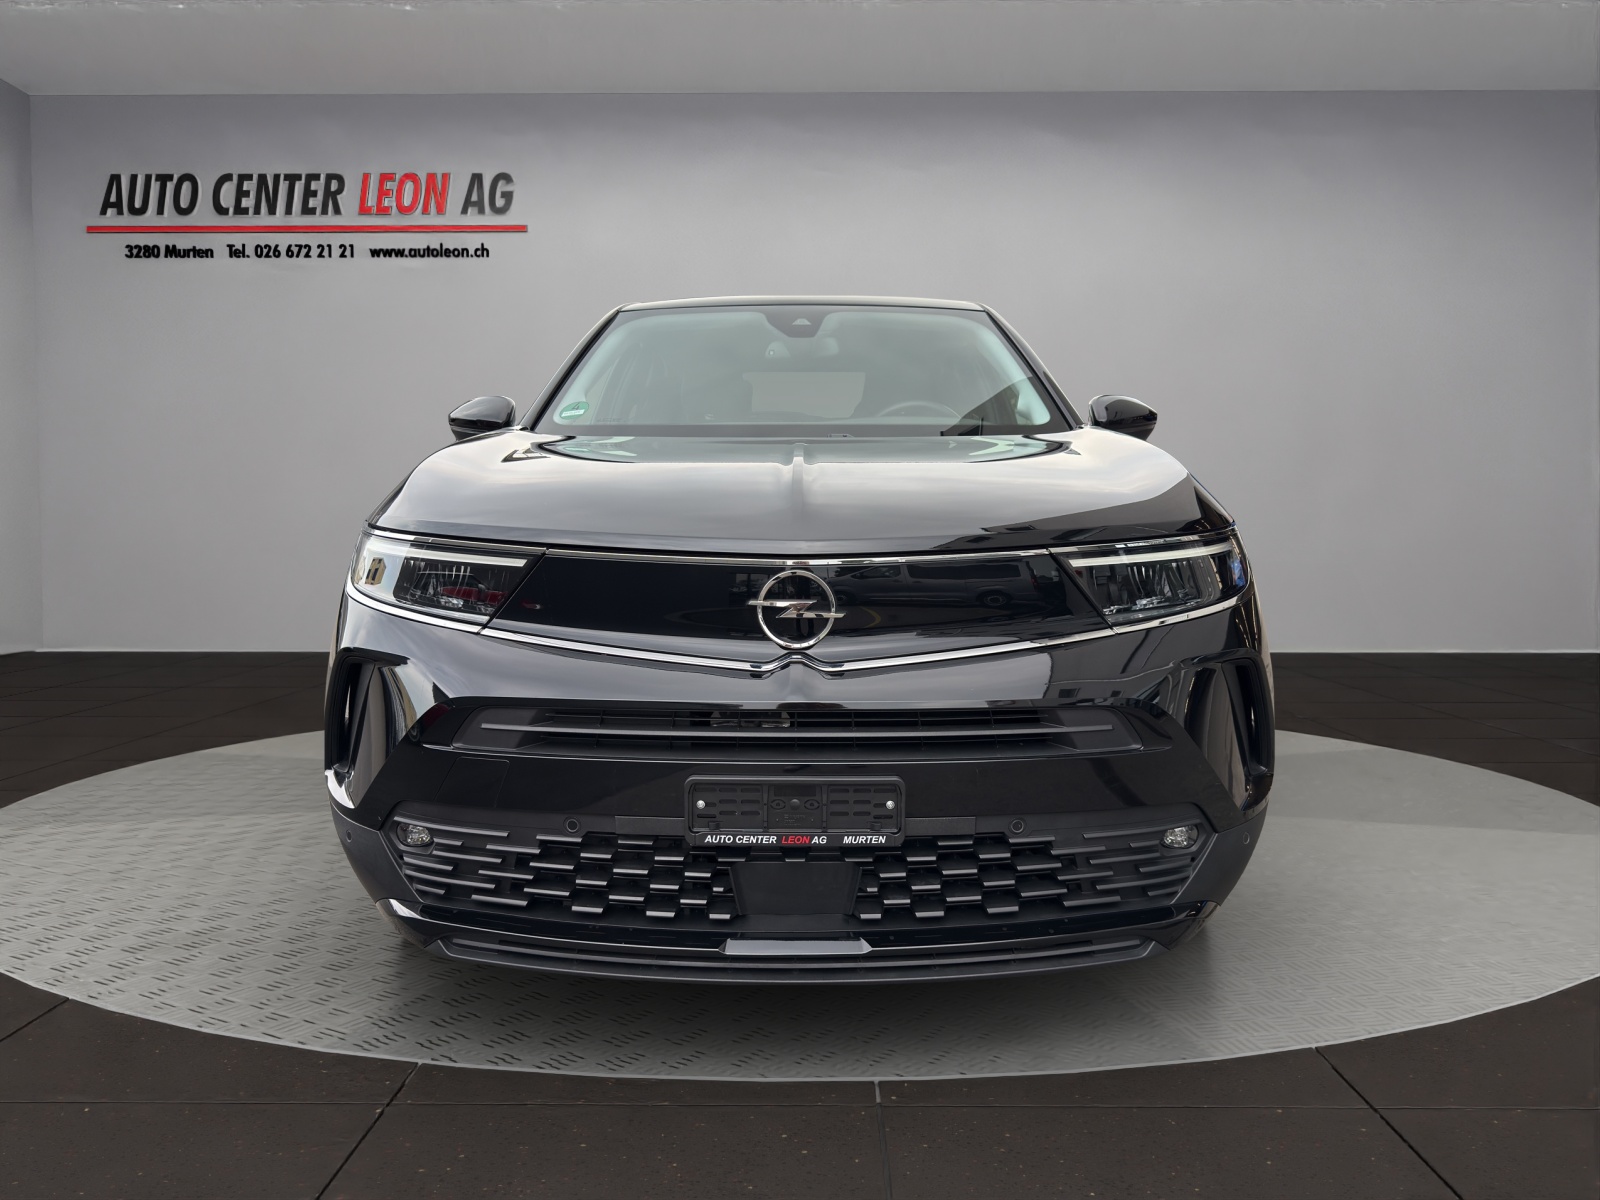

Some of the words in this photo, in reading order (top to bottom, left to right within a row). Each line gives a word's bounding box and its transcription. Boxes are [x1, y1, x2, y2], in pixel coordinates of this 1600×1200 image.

[100, 173, 199, 215] AUTO
[212, 173, 345, 215] CENTER
[358, 173, 450, 215] LEON
[461, 173, 514, 215] AG
[124, 244, 160, 259] 3280
[164, 244, 214, 259] Murten
[226, 244, 250, 259] Tel.
[254, 244, 282, 259] 026
[286, 244, 312, 259] 672
[316, 244, 334, 259] 21
[338, 244, 355, 259] 21
[369, 243, 490, 259] www.autoleon.ch
[704, 835, 733, 844] AUTO
[735, 835, 777, 844] CENTER
[781, 835, 810, 844] LEON
[811, 835, 827, 844] AG
[843, 835, 886, 844] MURTEN
